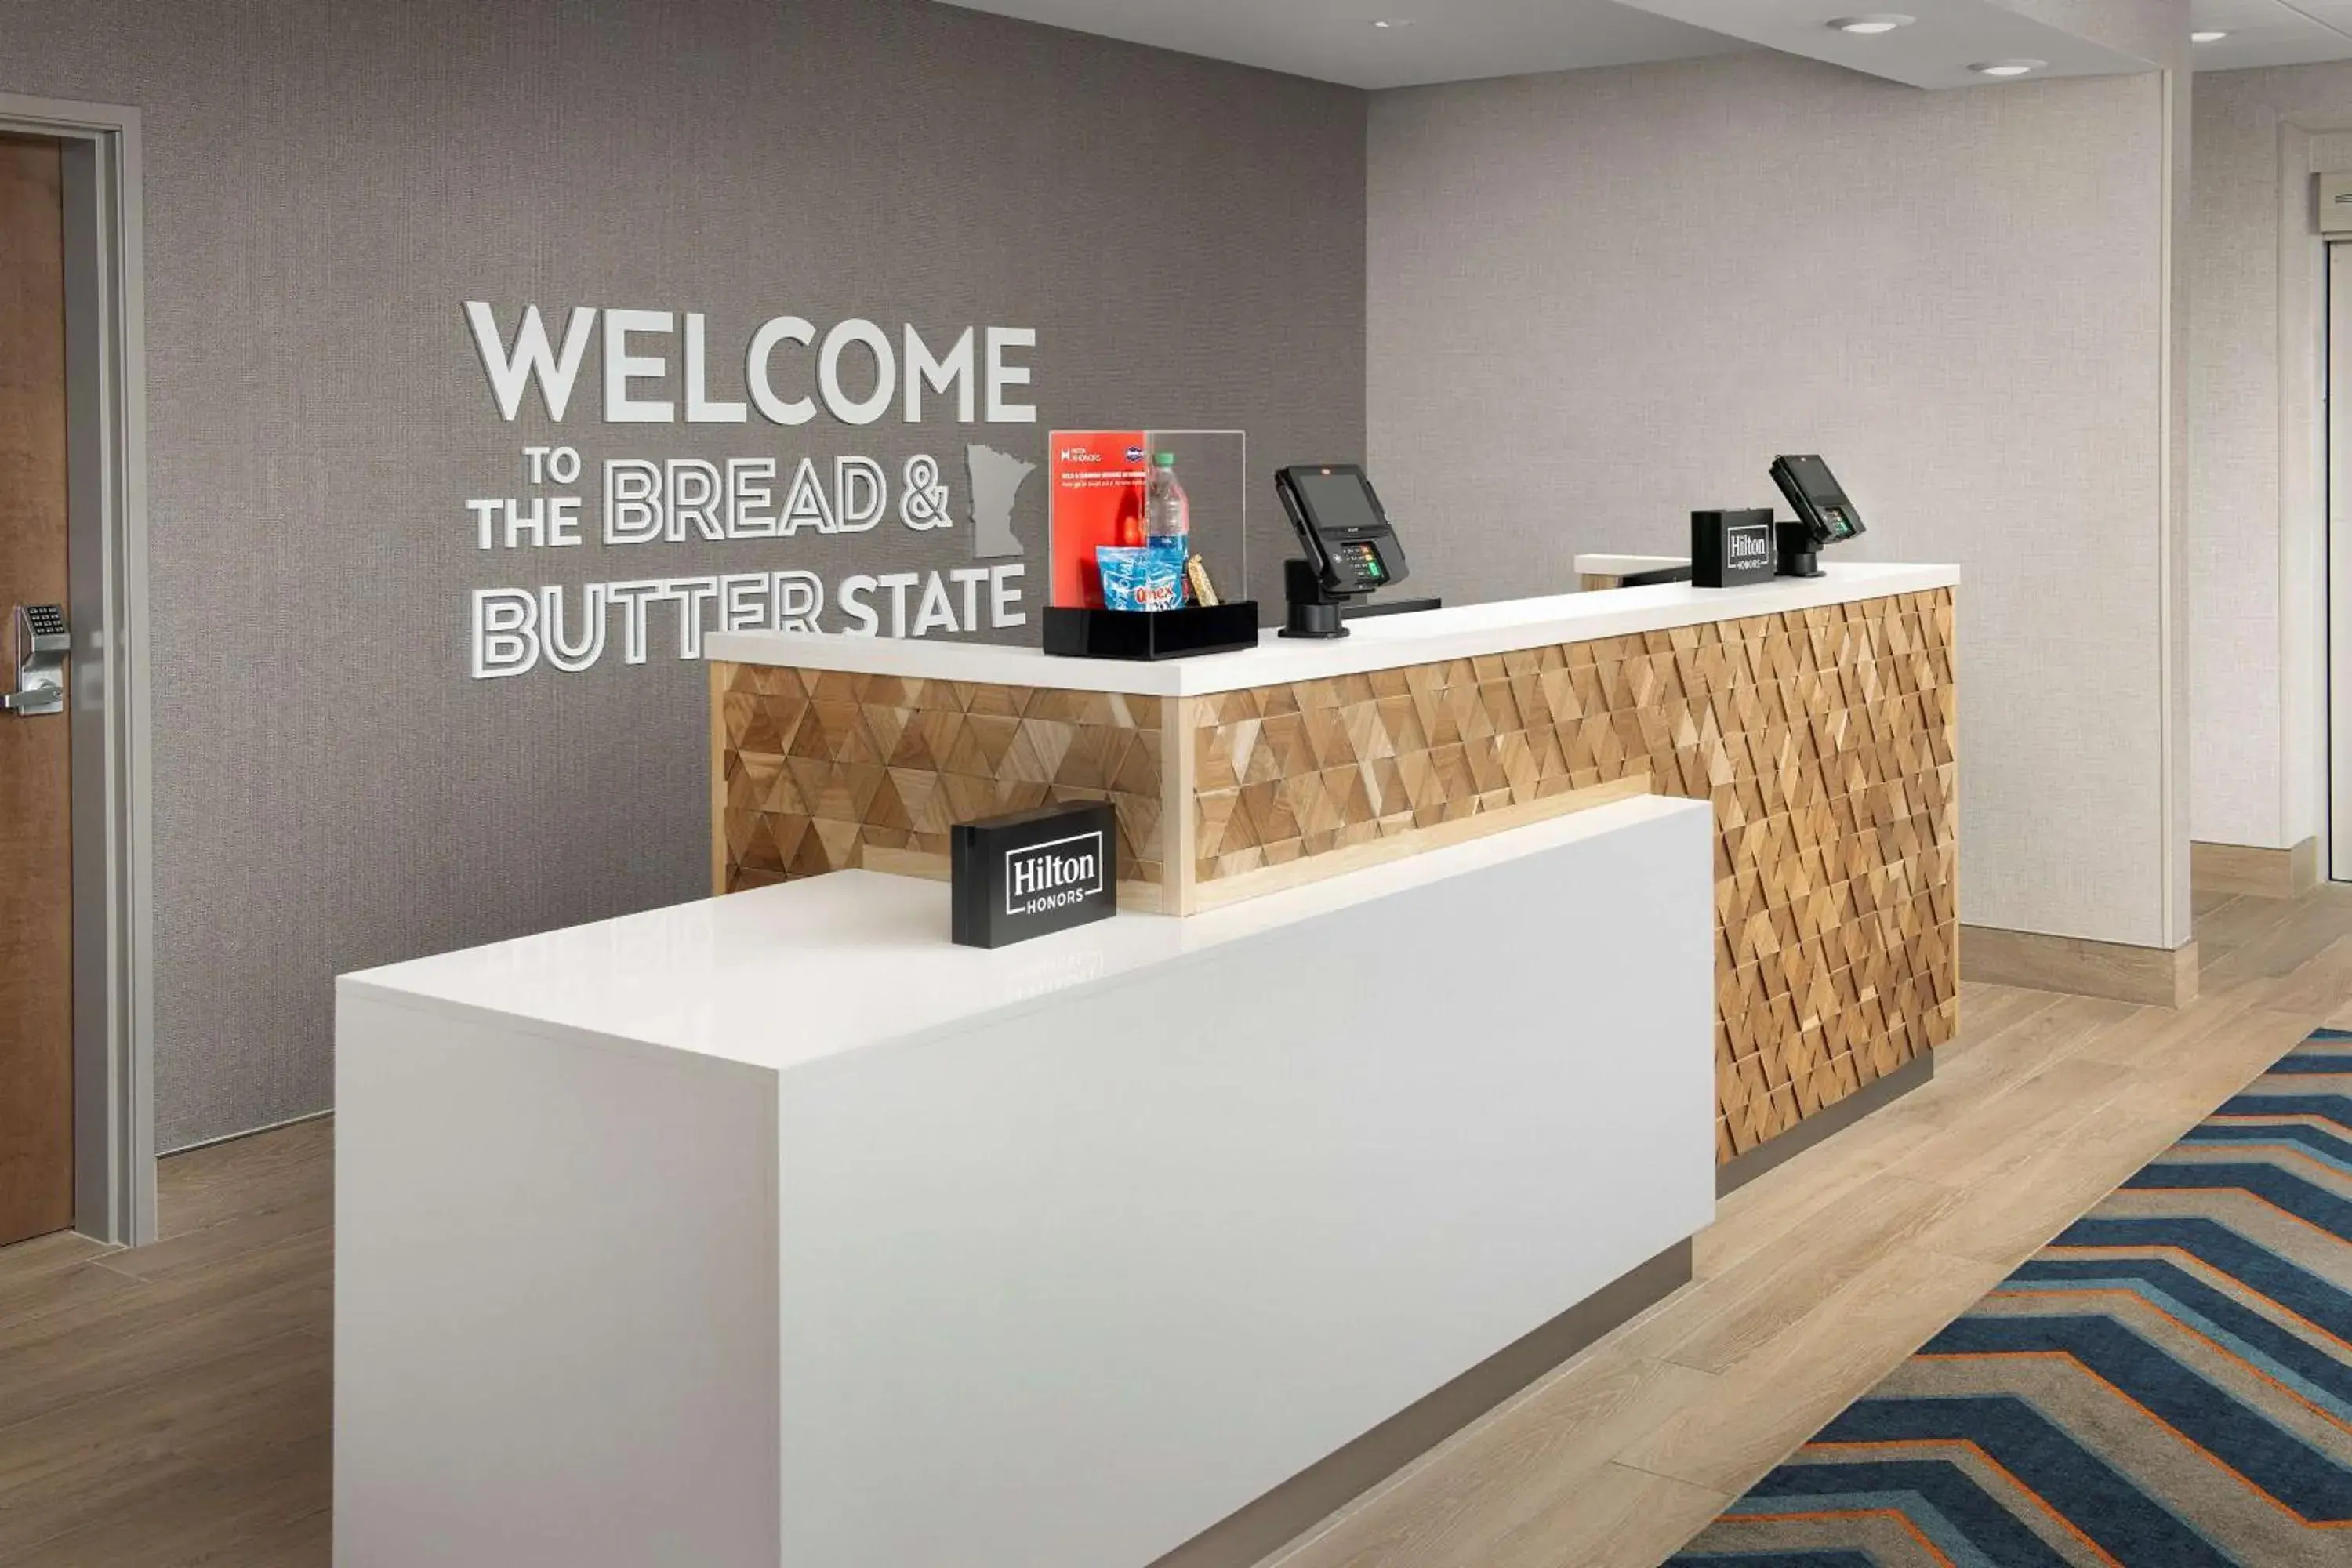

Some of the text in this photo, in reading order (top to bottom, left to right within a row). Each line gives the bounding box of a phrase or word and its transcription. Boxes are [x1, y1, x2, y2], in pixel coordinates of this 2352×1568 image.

[463, 300, 1037, 426] WELCOME
[522, 445, 582, 485] TO
[466, 453, 953, 550] THE BREAD &
[1731, 534, 1766, 557] Hilton
[472, 570, 824, 680] BUTTER
[837, 564, 1027, 639] STATE
[1014, 853, 1095, 897] Hilton
[1025, 887, 1085, 916] HONORS
